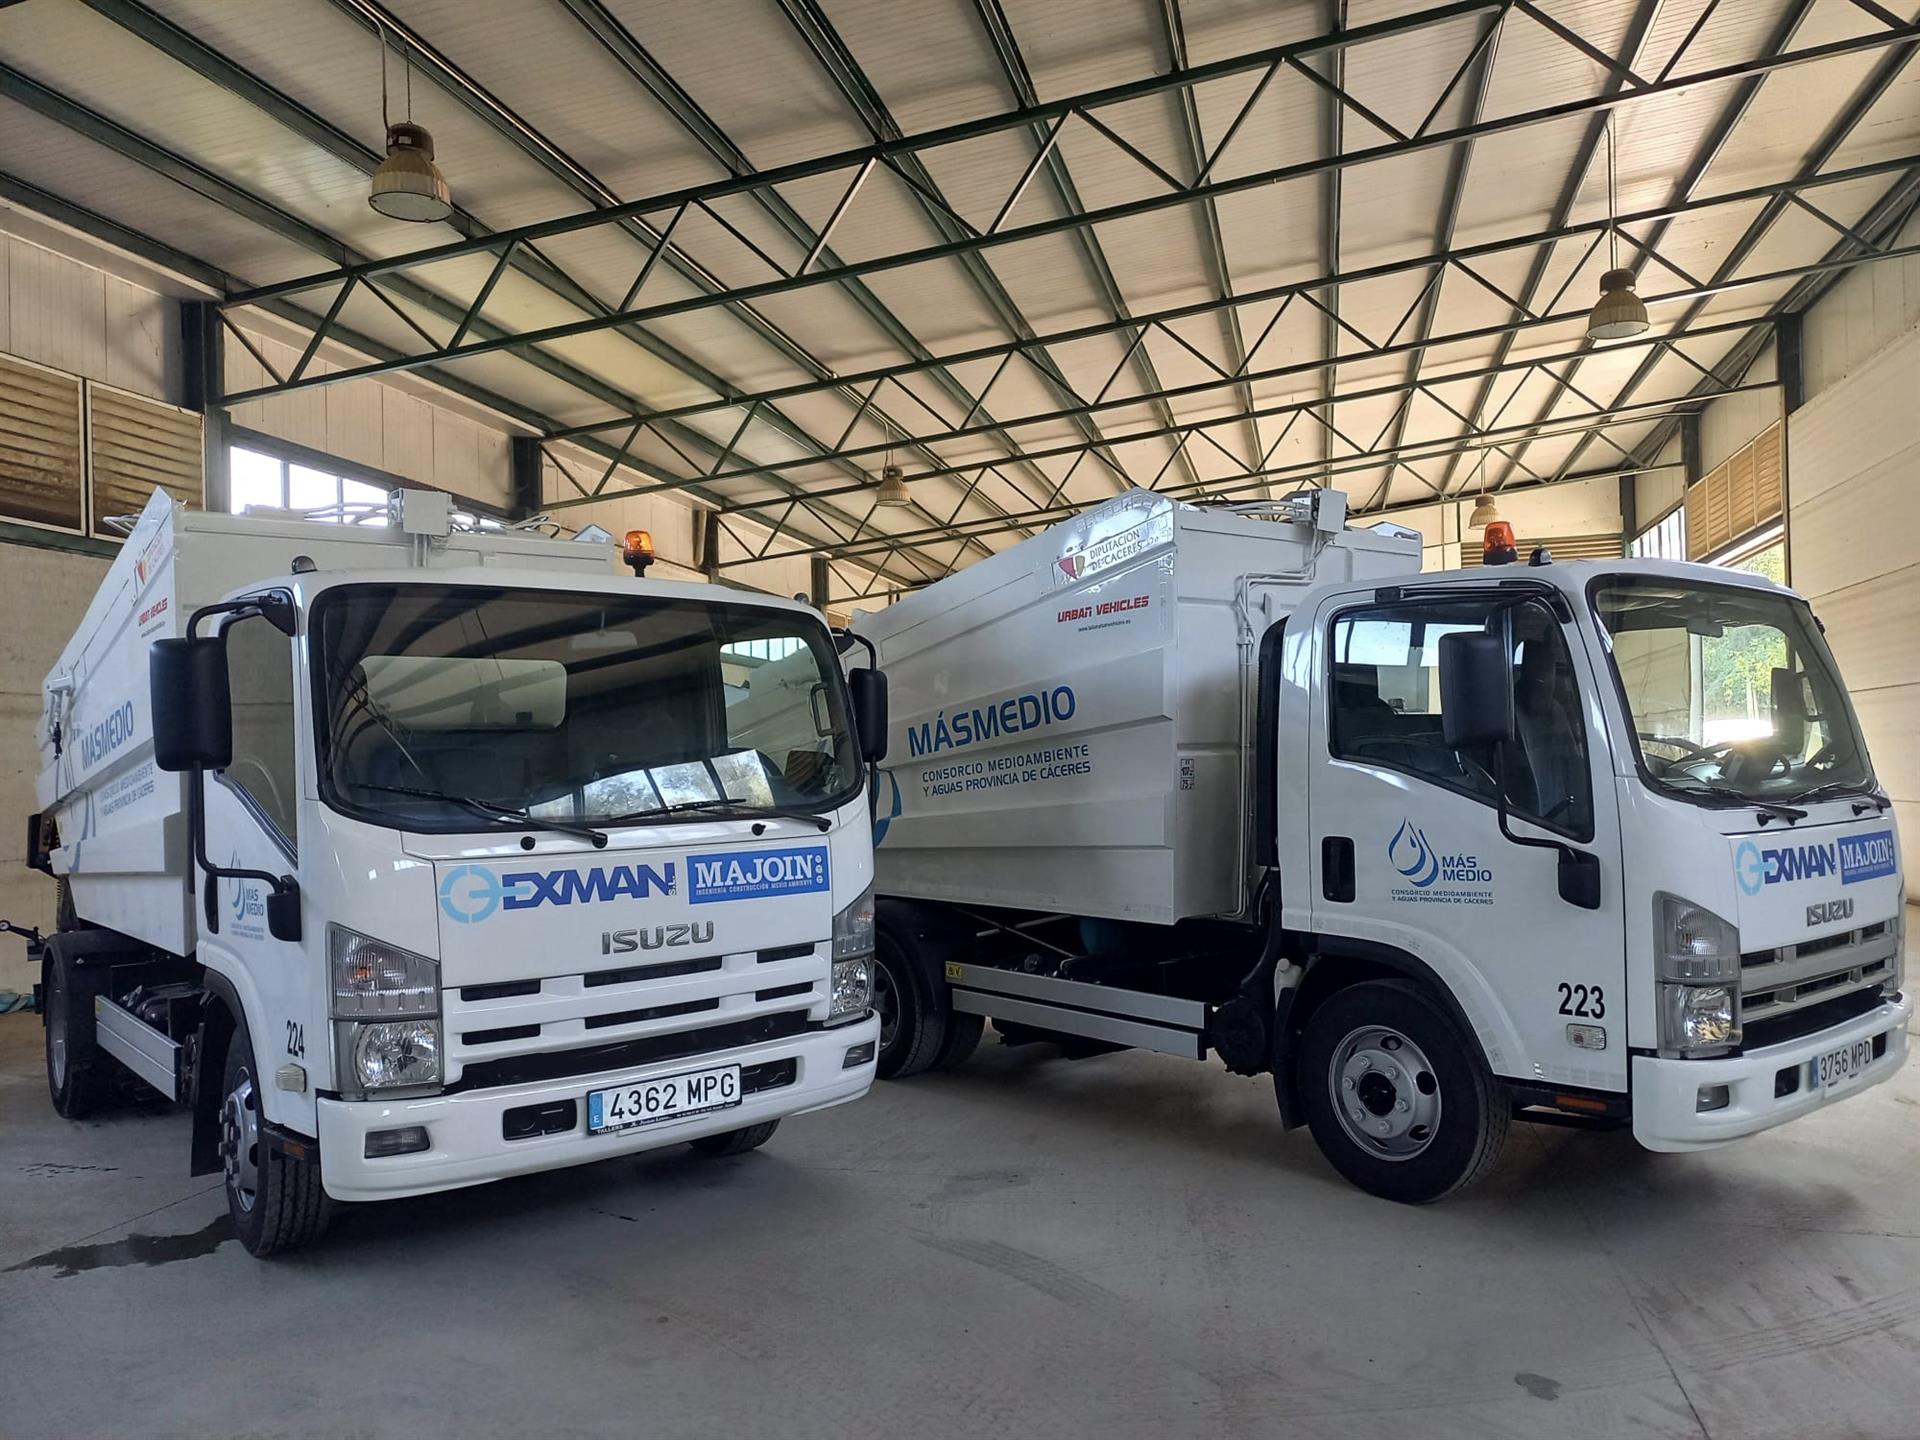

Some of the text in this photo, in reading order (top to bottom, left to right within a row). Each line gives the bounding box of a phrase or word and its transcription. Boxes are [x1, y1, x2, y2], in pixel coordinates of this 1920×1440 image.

[1057, 596, 1149, 623] URBAN VEHICLES
[81, 700, 134, 770] MÁSMEDIO
[908, 686, 1076, 757] MÁSMEDIO
[922, 744, 1089, 783] CONSORCIO MEDIOAMBIENTE
[923, 761, 1091, 797] Y AGUAS PROVINCIA DE CÁCERES
[1442, 853, 1477, 868] MÁS
[1841, 838, 1889, 869] MAJOIN
[695, 854, 813, 888] MAJOIN
[1443, 870, 1492, 882] MEDIO
[246, 902, 264, 916] MEDIO
[1391, 889, 1492, 898] CONSORCIO MEDIOAMBIENTE
[1806, 898, 1854, 927] ISUZU
[602, 920, 714, 955] ISUZU
[1558, 982, 1605, 1019] 223
[286, 1019, 305, 1060] 224
[1821, 1040, 1871, 1081] 3756 MPD
[610, 1083, 677, 1119] 4362
[687, 1073, 734, 1105] MPG
[594, 1114, 600, 1123] E
